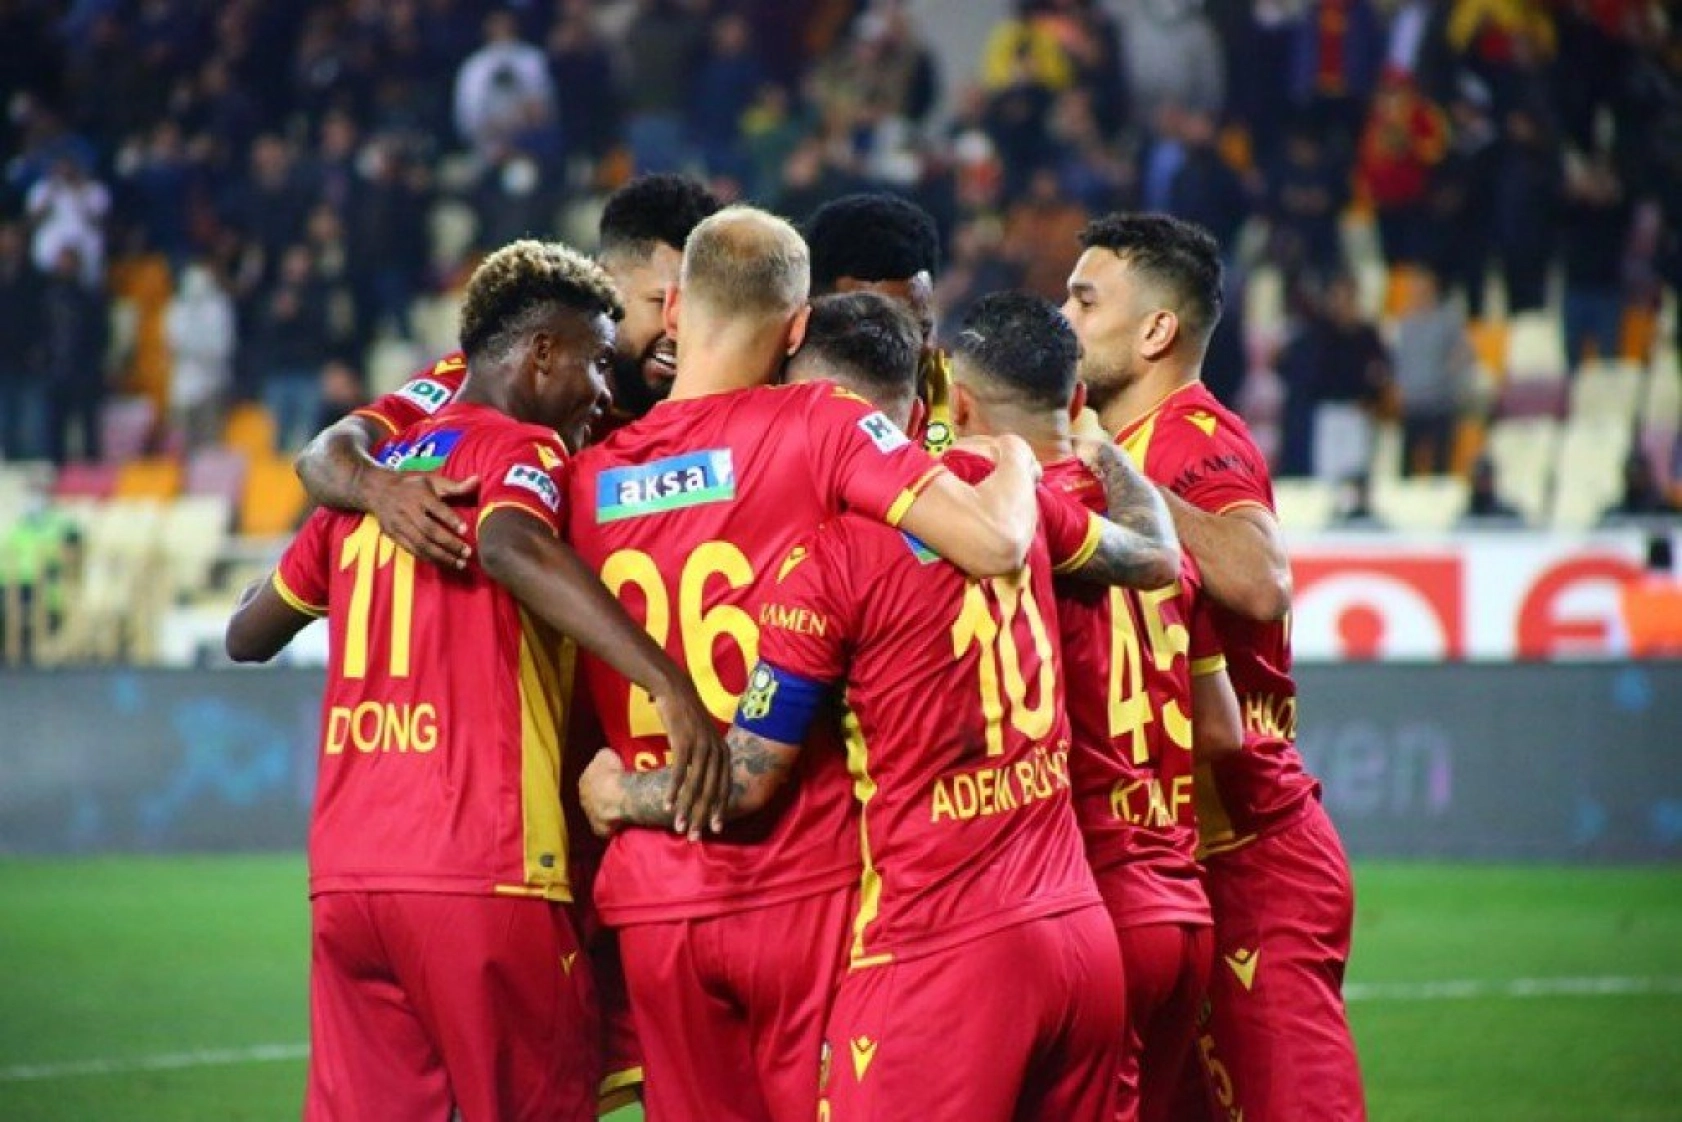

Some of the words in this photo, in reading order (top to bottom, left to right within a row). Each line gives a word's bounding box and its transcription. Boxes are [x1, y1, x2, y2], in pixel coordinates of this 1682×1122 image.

[618, 464, 706, 506] aksa
[339, 513, 415, 678] 11
[601, 541, 760, 738] 26
[952, 563, 1056, 758] 10
[1108, 583, 1193, 765] 45
[326, 701, 438, 755] DONG
[930, 766, 1018, 822] ADEM
